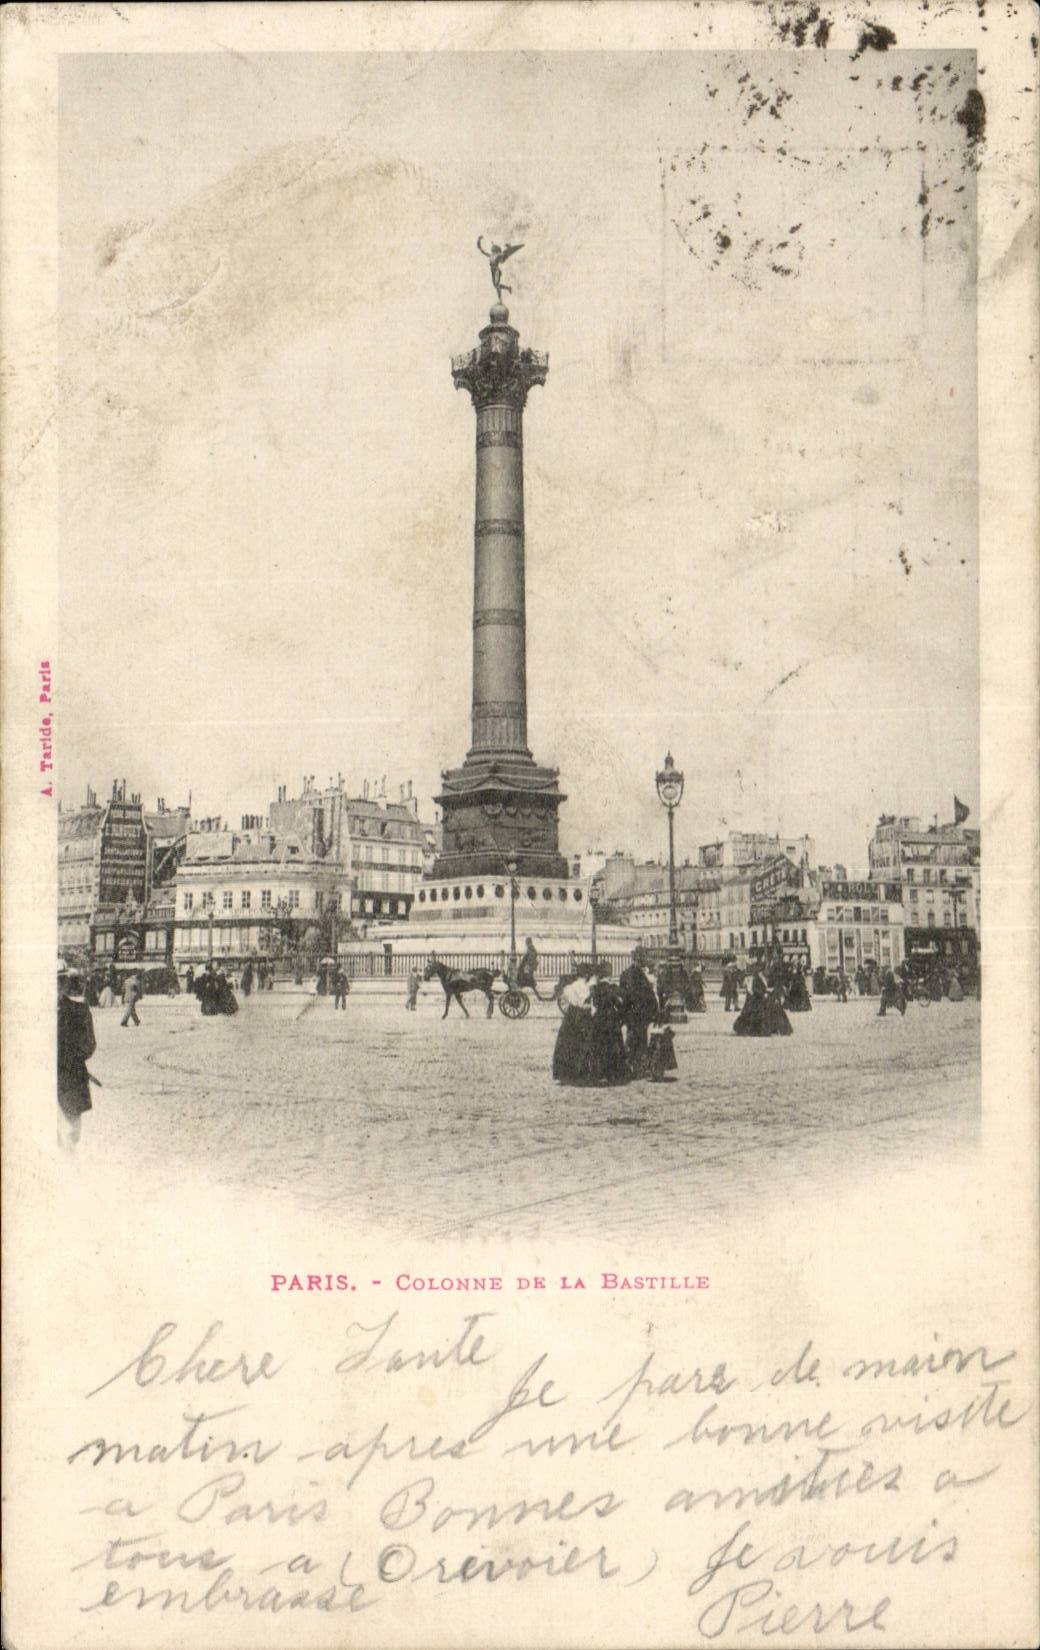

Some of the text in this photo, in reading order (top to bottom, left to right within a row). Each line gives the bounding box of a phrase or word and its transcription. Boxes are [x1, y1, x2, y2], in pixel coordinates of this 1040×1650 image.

[37, 658, 55, 797] A. Taride, Paris
[271, 1273, 357, 1292] PARIS.
[516, 1276, 545, 1290] DE
[560, 1276, 586, 1290] LA
[663, 1403, 848, 1450] bonne
[176, 1472, 328, 1527] Paris
[380, 1477, 626, 1533] Bonnes
[688, 1521, 765, 1596] Je
[698, 1580, 893, 1639] Pierre
